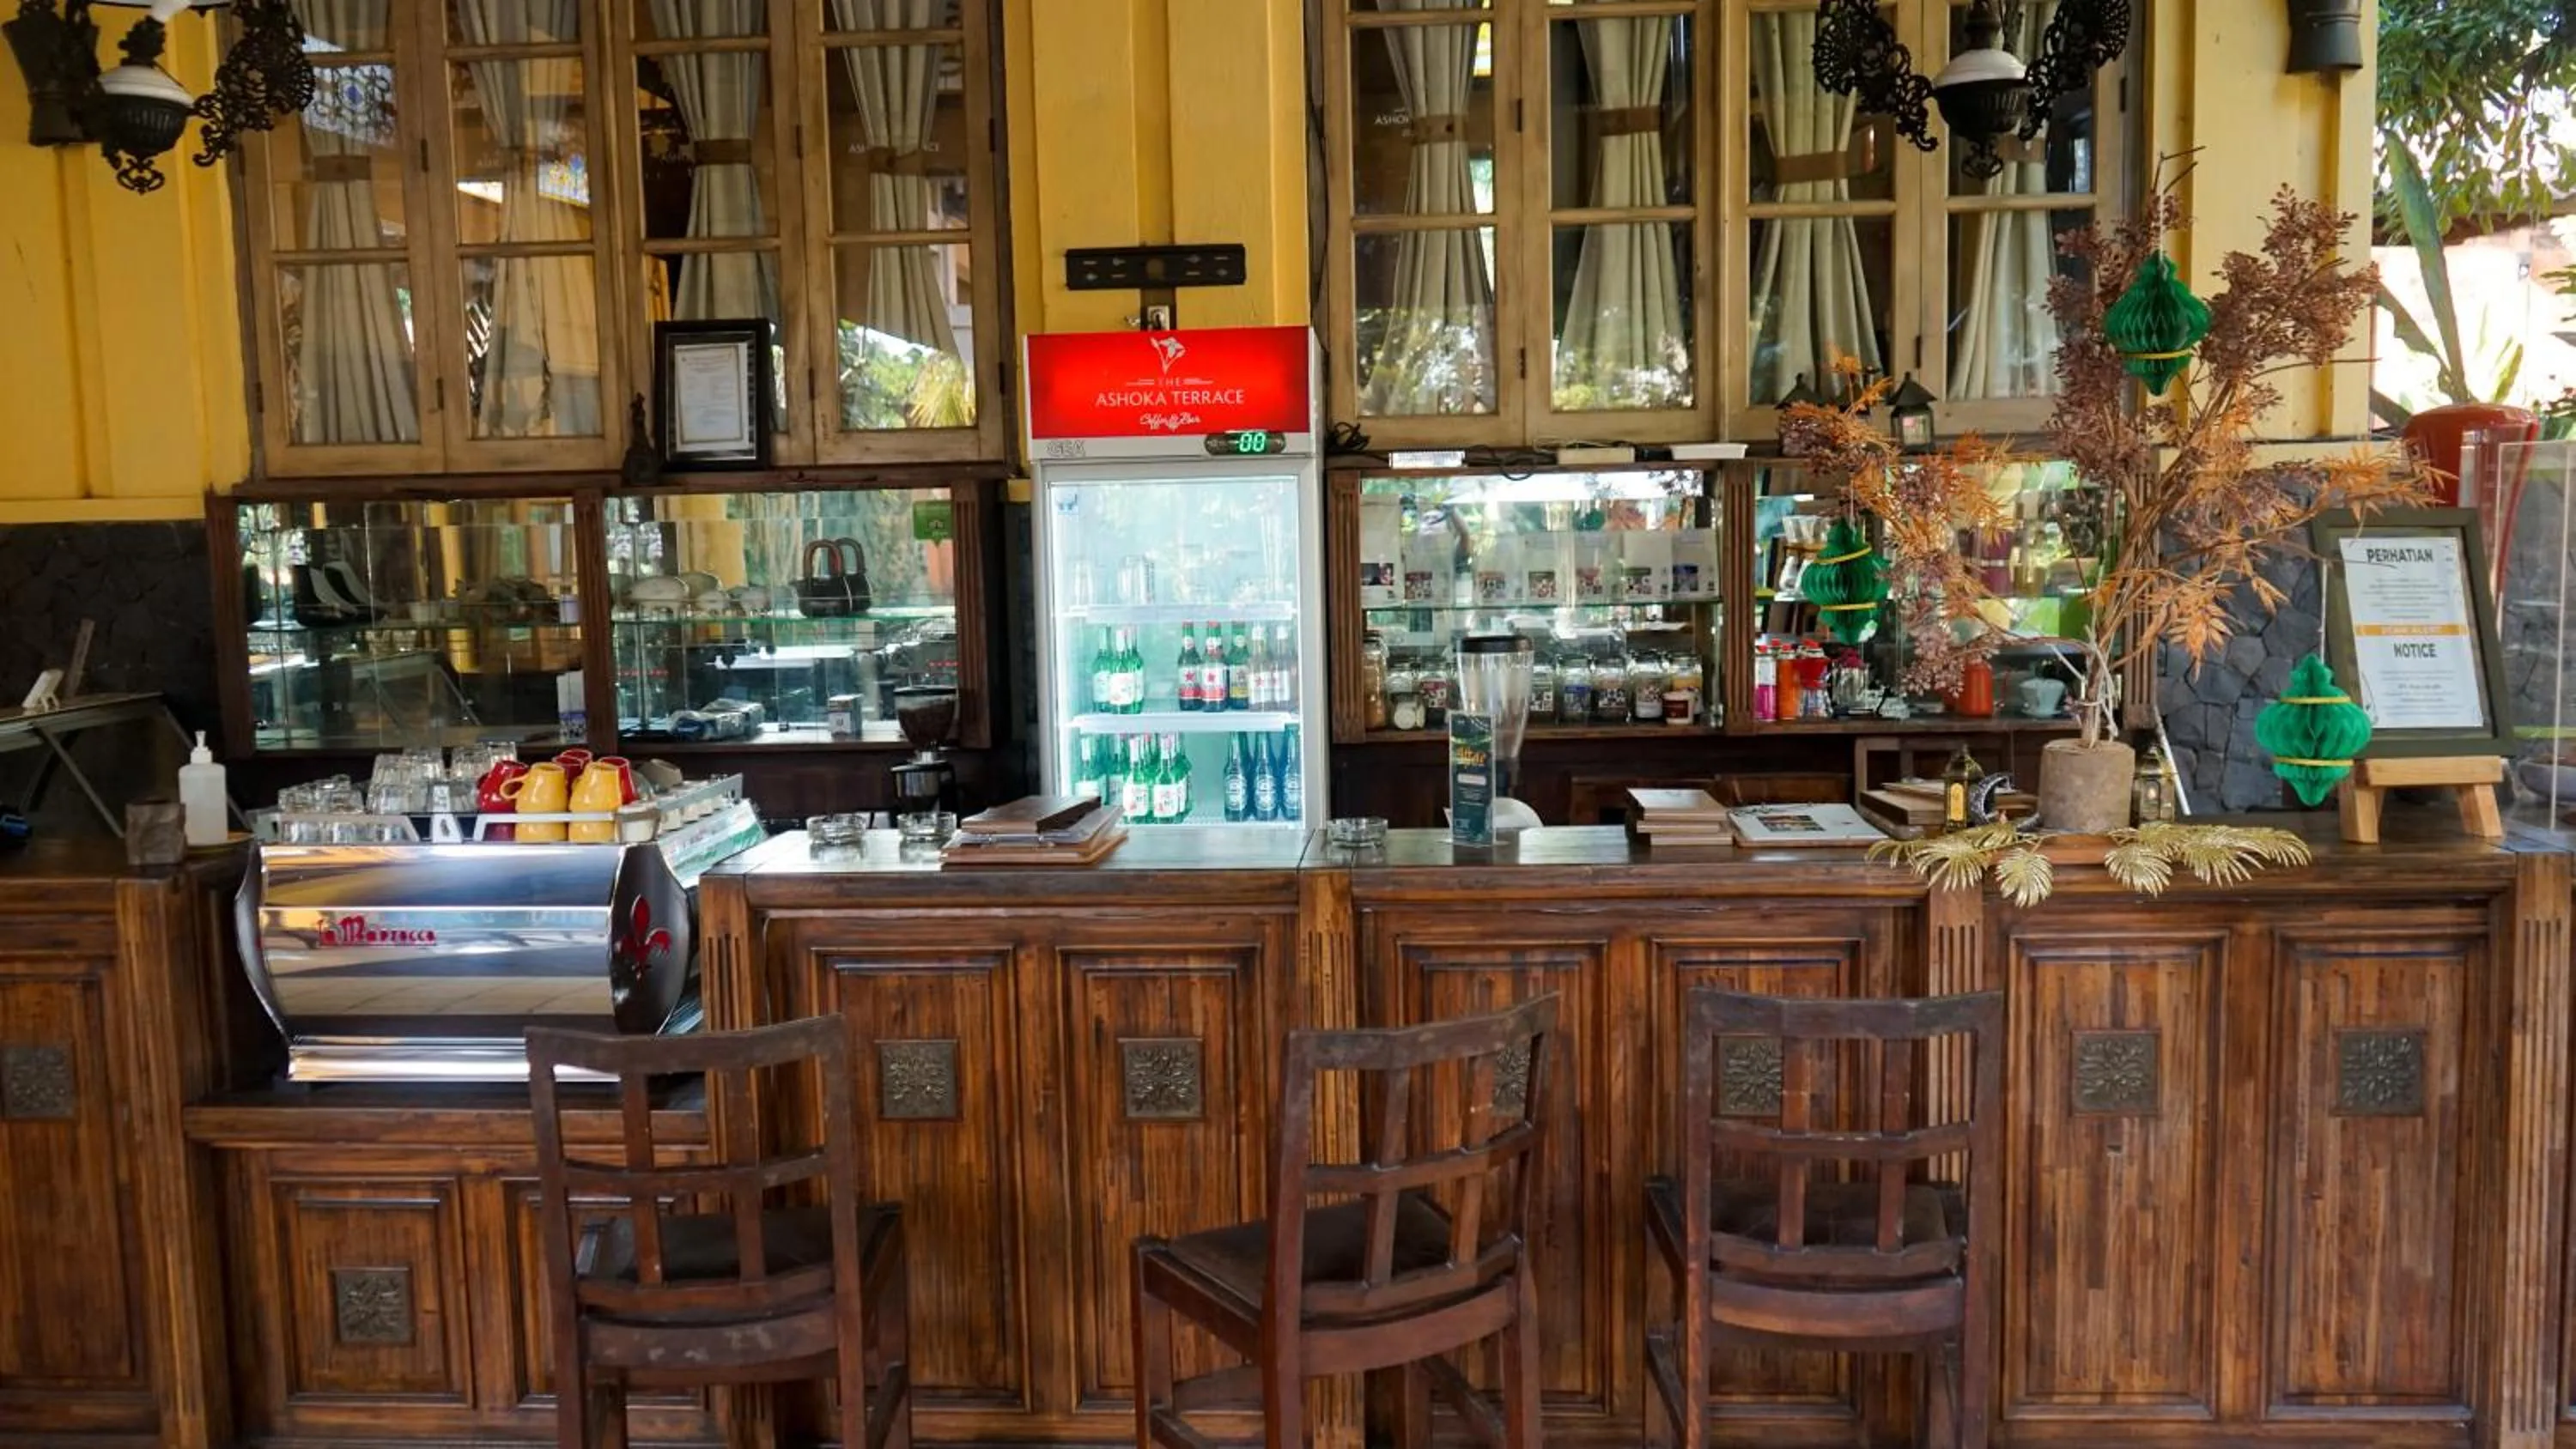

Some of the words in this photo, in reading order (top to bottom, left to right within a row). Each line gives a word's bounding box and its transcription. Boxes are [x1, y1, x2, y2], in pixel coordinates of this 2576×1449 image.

[1095, 391, 1167, 408] ASHOKA
[1171, 388, 1245, 405] TERRACE
[2366, 548, 2433, 563] PERHATIAN
[2393, 642, 2438, 659] NOTICE
